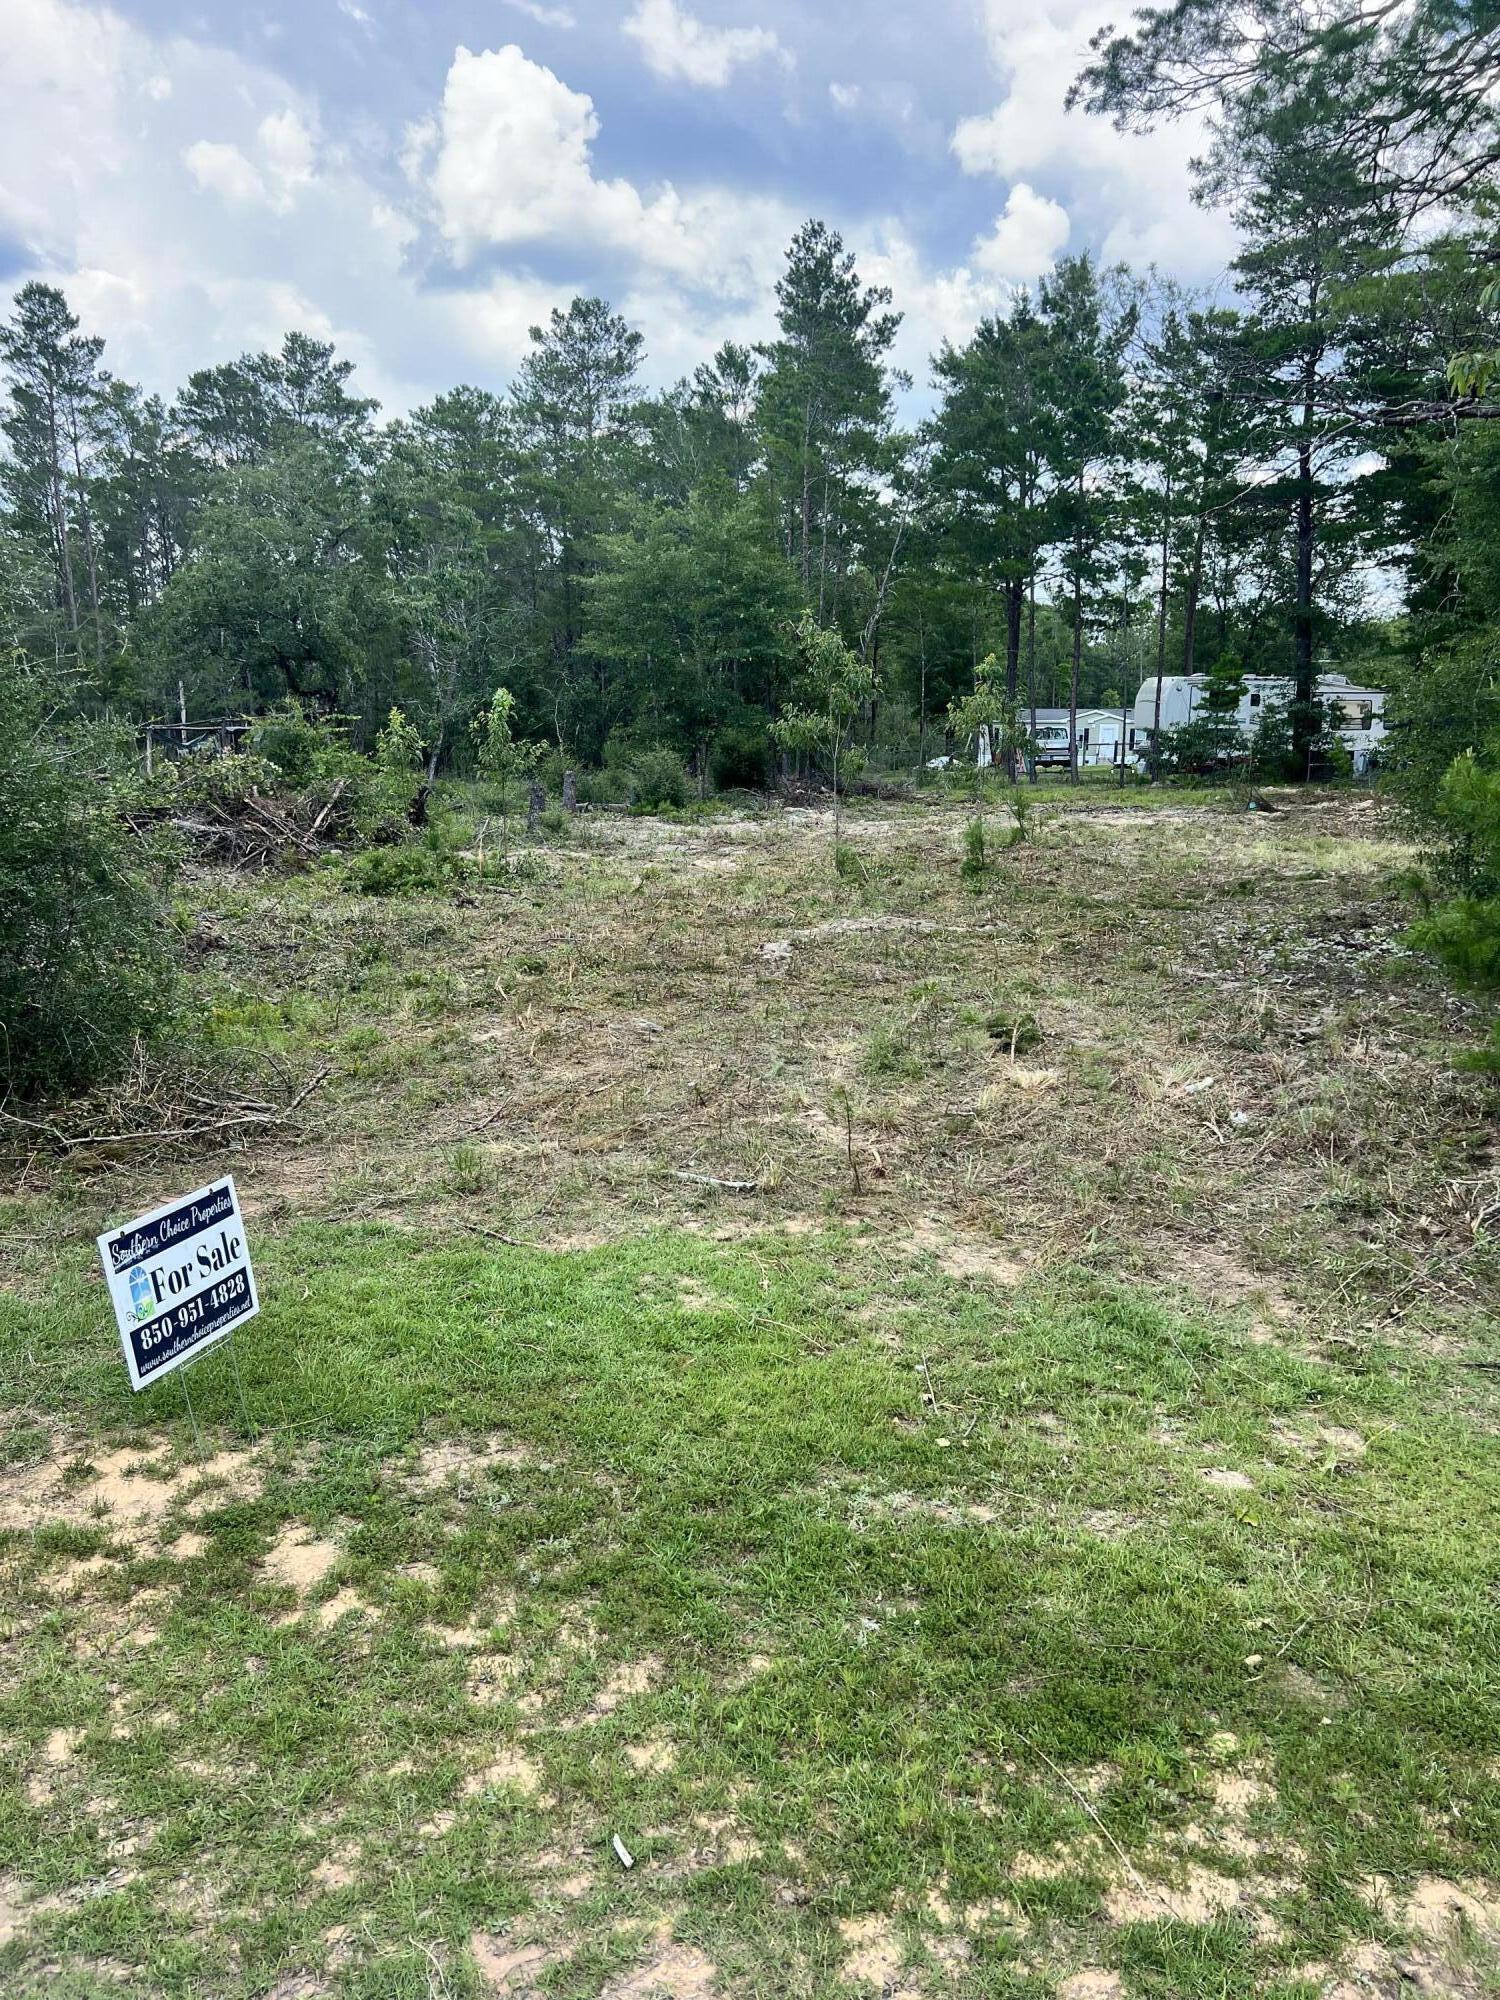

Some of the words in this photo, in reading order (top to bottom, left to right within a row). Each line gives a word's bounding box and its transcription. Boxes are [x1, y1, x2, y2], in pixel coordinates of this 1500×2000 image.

[112, 1233, 158, 1265] Southern
[160, 1218, 190, 1242] Choice
[190, 1196, 232, 1227] Properties
[149, 1263, 192, 1304] For
[196, 1232, 241, 1278] Sale
[140, 1273, 245, 1350] 850-951-4828
